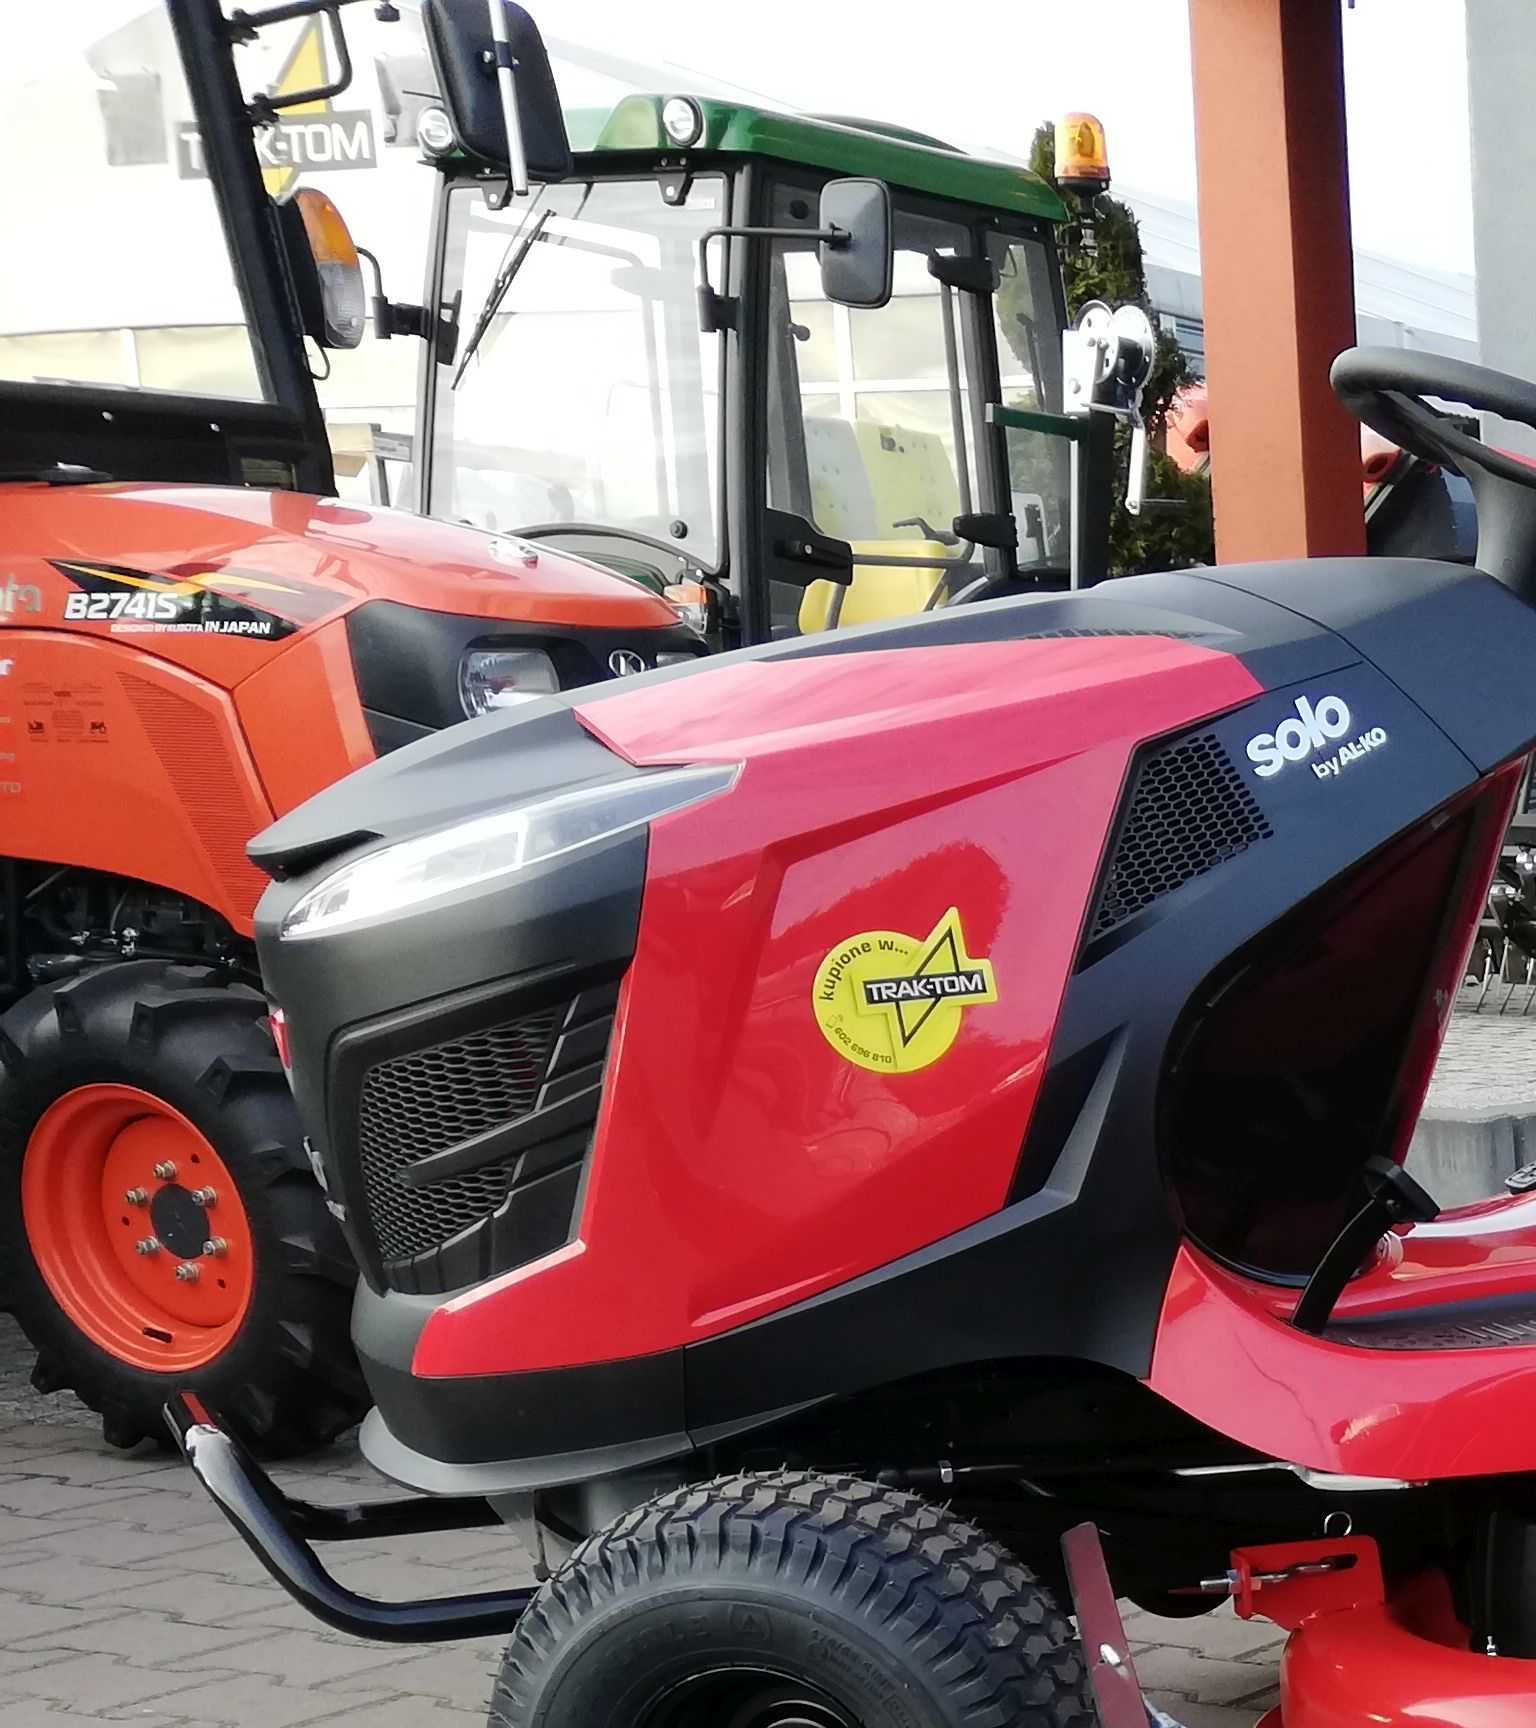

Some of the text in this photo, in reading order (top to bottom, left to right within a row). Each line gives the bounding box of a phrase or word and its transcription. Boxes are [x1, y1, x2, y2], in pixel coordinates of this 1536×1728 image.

[180, 121, 371, 169] TK-TOM
[218, 621, 272, 635] JAPAN
[1247, 695, 1350, 777] solo
[1311, 727, 1387, 780] by AL-KO
[819, 941, 873, 1001] kupione
[865, 973, 983, 1001] TRAK-TOM
